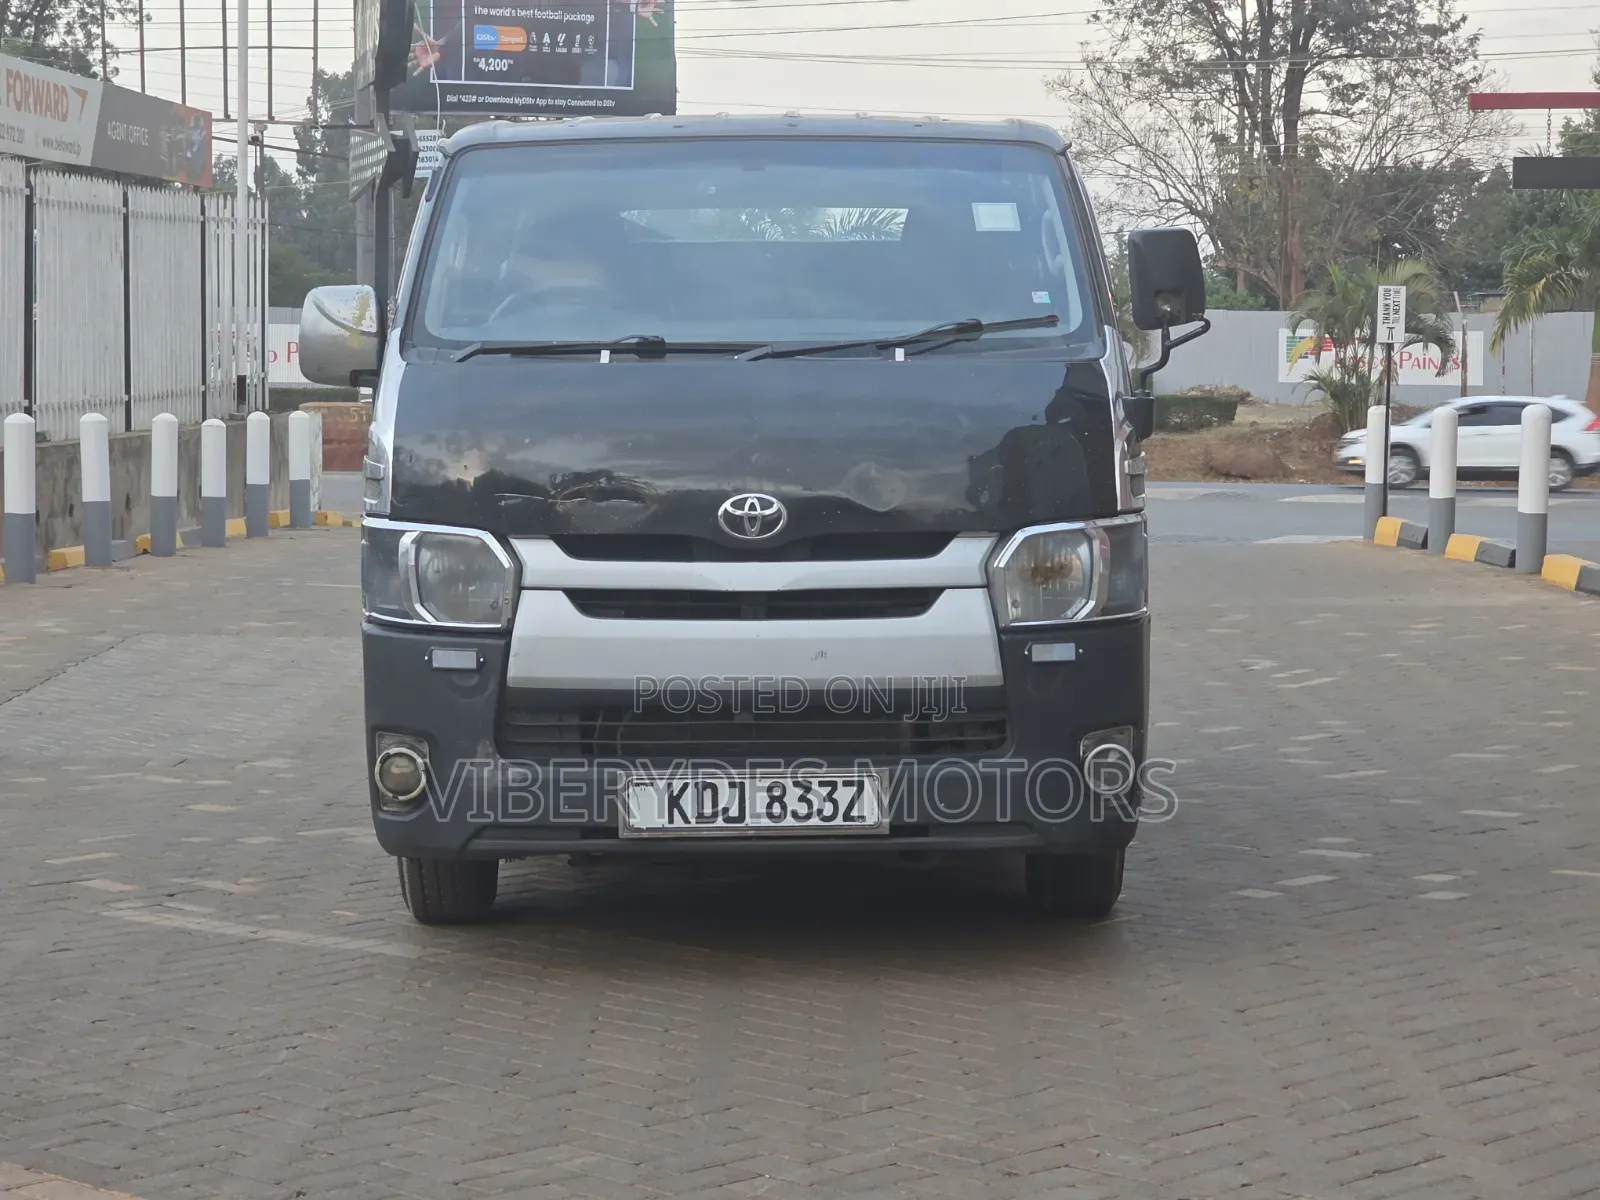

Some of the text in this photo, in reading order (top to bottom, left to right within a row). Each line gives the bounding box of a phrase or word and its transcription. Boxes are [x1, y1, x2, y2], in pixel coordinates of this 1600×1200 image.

[474, 5, 595, 24] The world's best football package
[501, 36, 523, 44] Compact
[6, 67, 69, 123] FORWARD
[446, 94, 459, 102] Dial
[485, 96, 514, 104] Download
[514, 97, 535, 106] MyDStv
[536, 98, 547, 106] App
[554, 99, 567, 107] stay
[567, 99, 596, 107] Connected
[107, 121, 149, 146] AGENT OFFICE
[1382, 287, 1392, 325] THANK YOU
[1392, 300, 1401, 316] NEXT
[667, 778, 867, 825] KDJ 833Z
